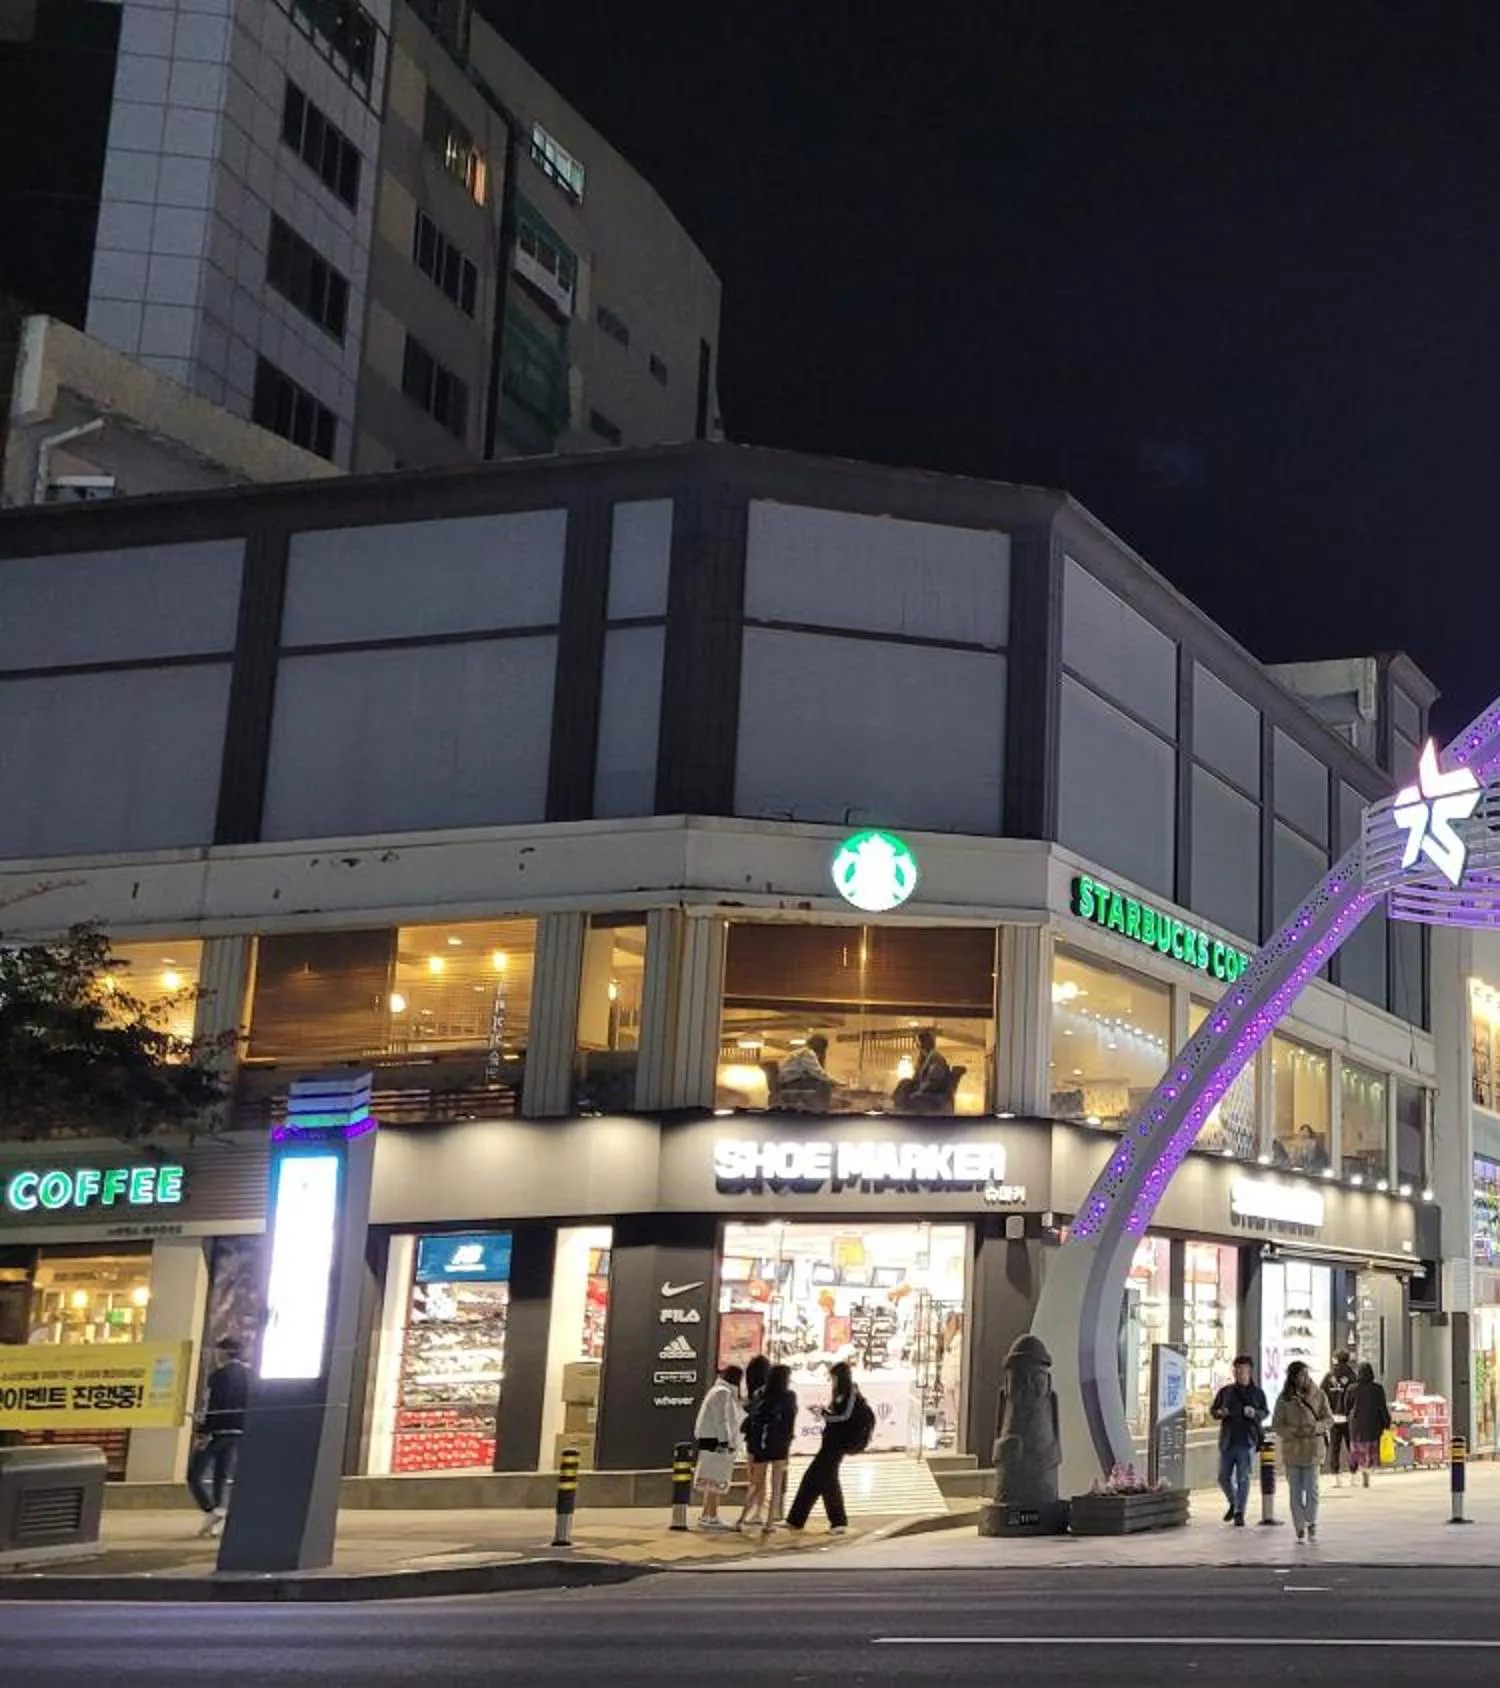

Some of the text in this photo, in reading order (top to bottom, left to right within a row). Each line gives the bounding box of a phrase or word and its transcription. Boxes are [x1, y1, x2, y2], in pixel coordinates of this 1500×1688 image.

[1076, 873, 1254, 984] STARBUCKS COF
[713, 1138, 1007, 1184] SHOE MARKER
[8, 1166, 184, 1211] COFFEE
[660, 1308, 701, 1323] FILA
[0, 1386, 67, 1411] 이벤트
